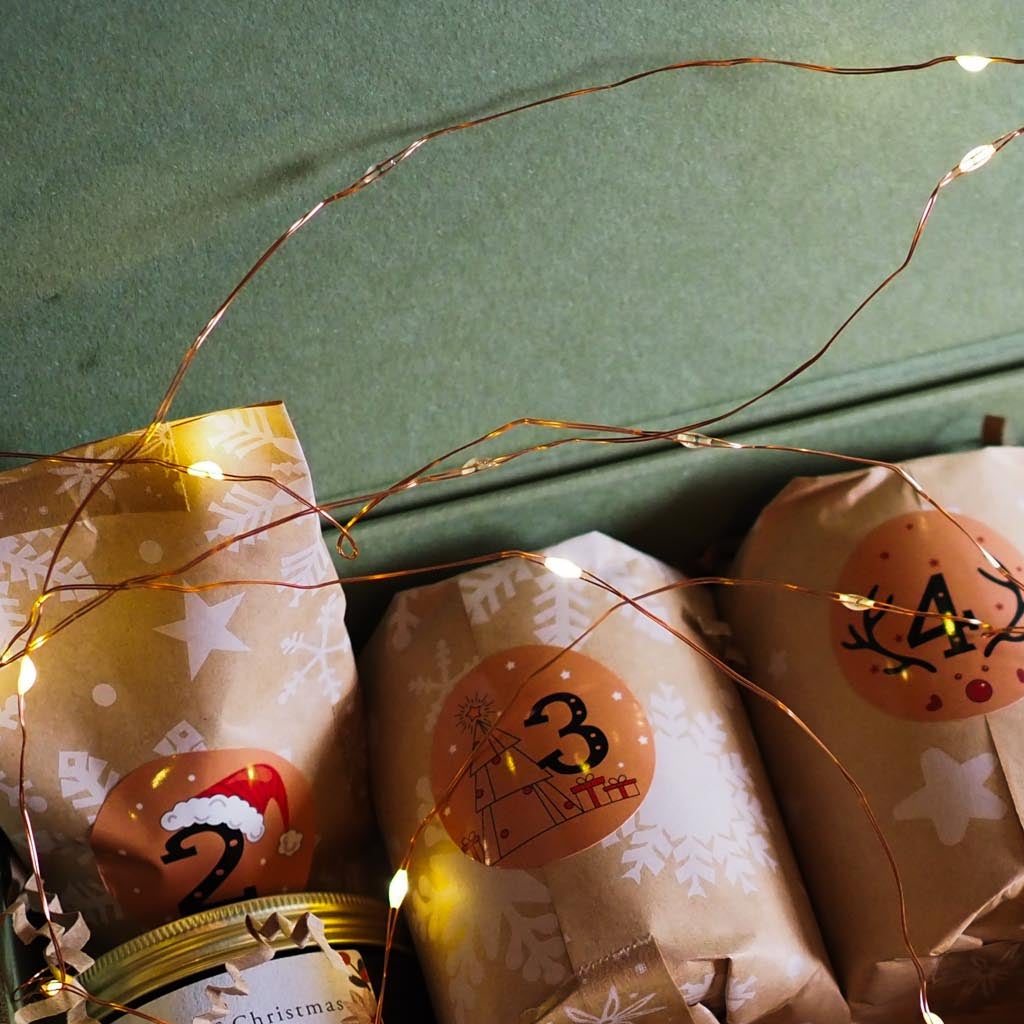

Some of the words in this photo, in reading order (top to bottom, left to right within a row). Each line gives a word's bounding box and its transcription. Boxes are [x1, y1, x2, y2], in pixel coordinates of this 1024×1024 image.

[906, 572, 980, 659] 4
[523, 691, 609, 776] 3
[159, 821, 260, 918] 2
